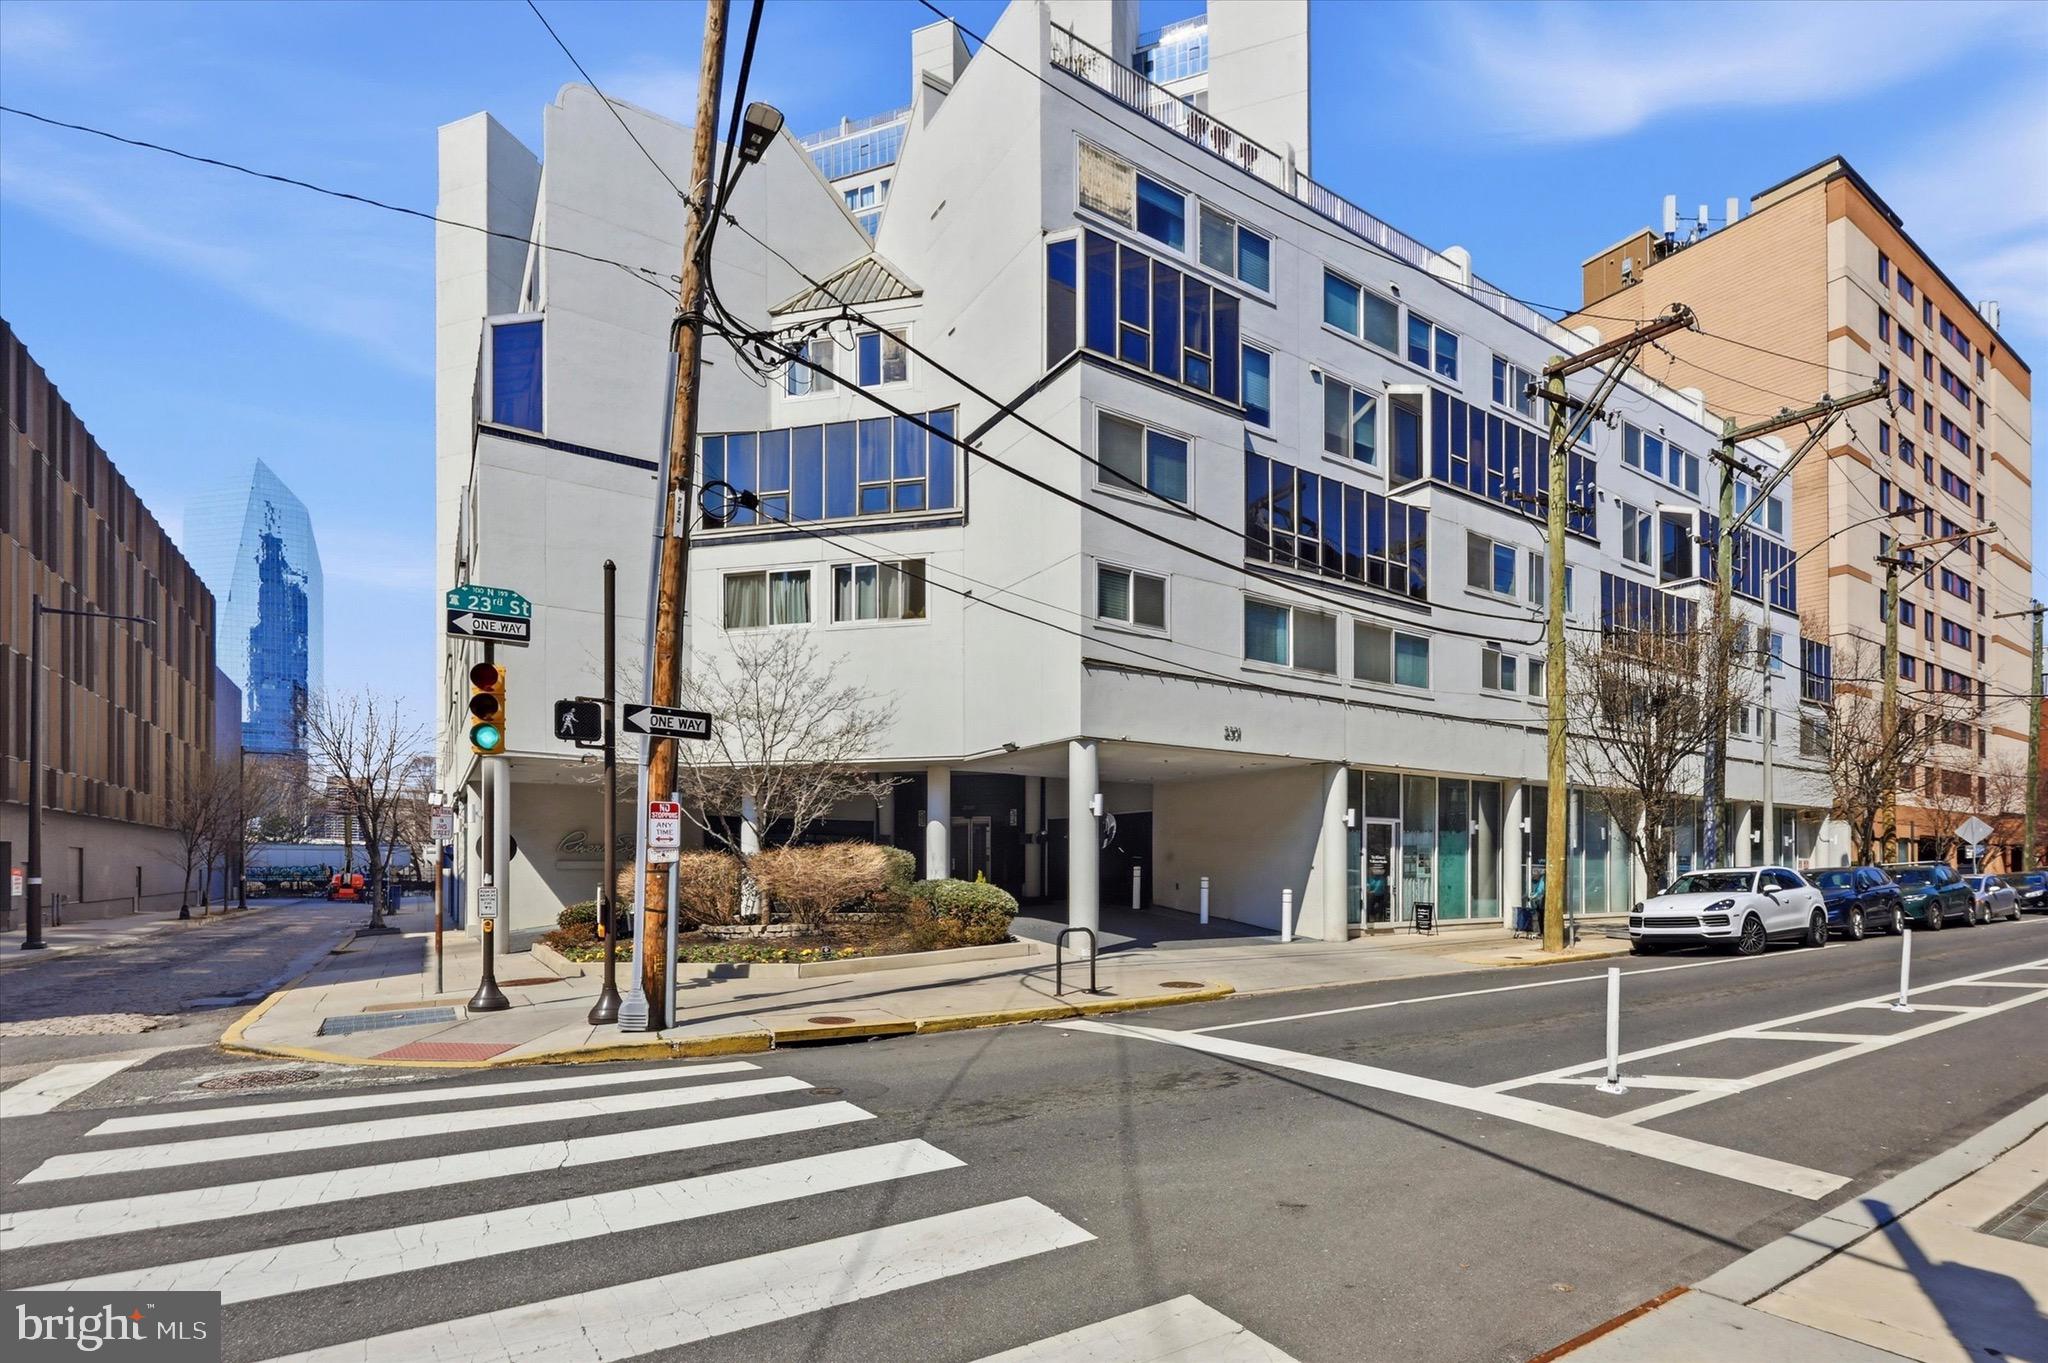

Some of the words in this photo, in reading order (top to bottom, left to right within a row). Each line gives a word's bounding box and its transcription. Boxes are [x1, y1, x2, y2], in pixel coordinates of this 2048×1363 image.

[487, 588, 495, 597] N
[467, 595, 503, 612] 23rd
[509, 600, 530, 617] St
[472, 619, 497, 632] ONE
[500, 622, 522, 634] WAY
[650, 715, 674, 729] ONE
[678, 718, 703, 732] WAY
[659, 803, 671, 813] NO
